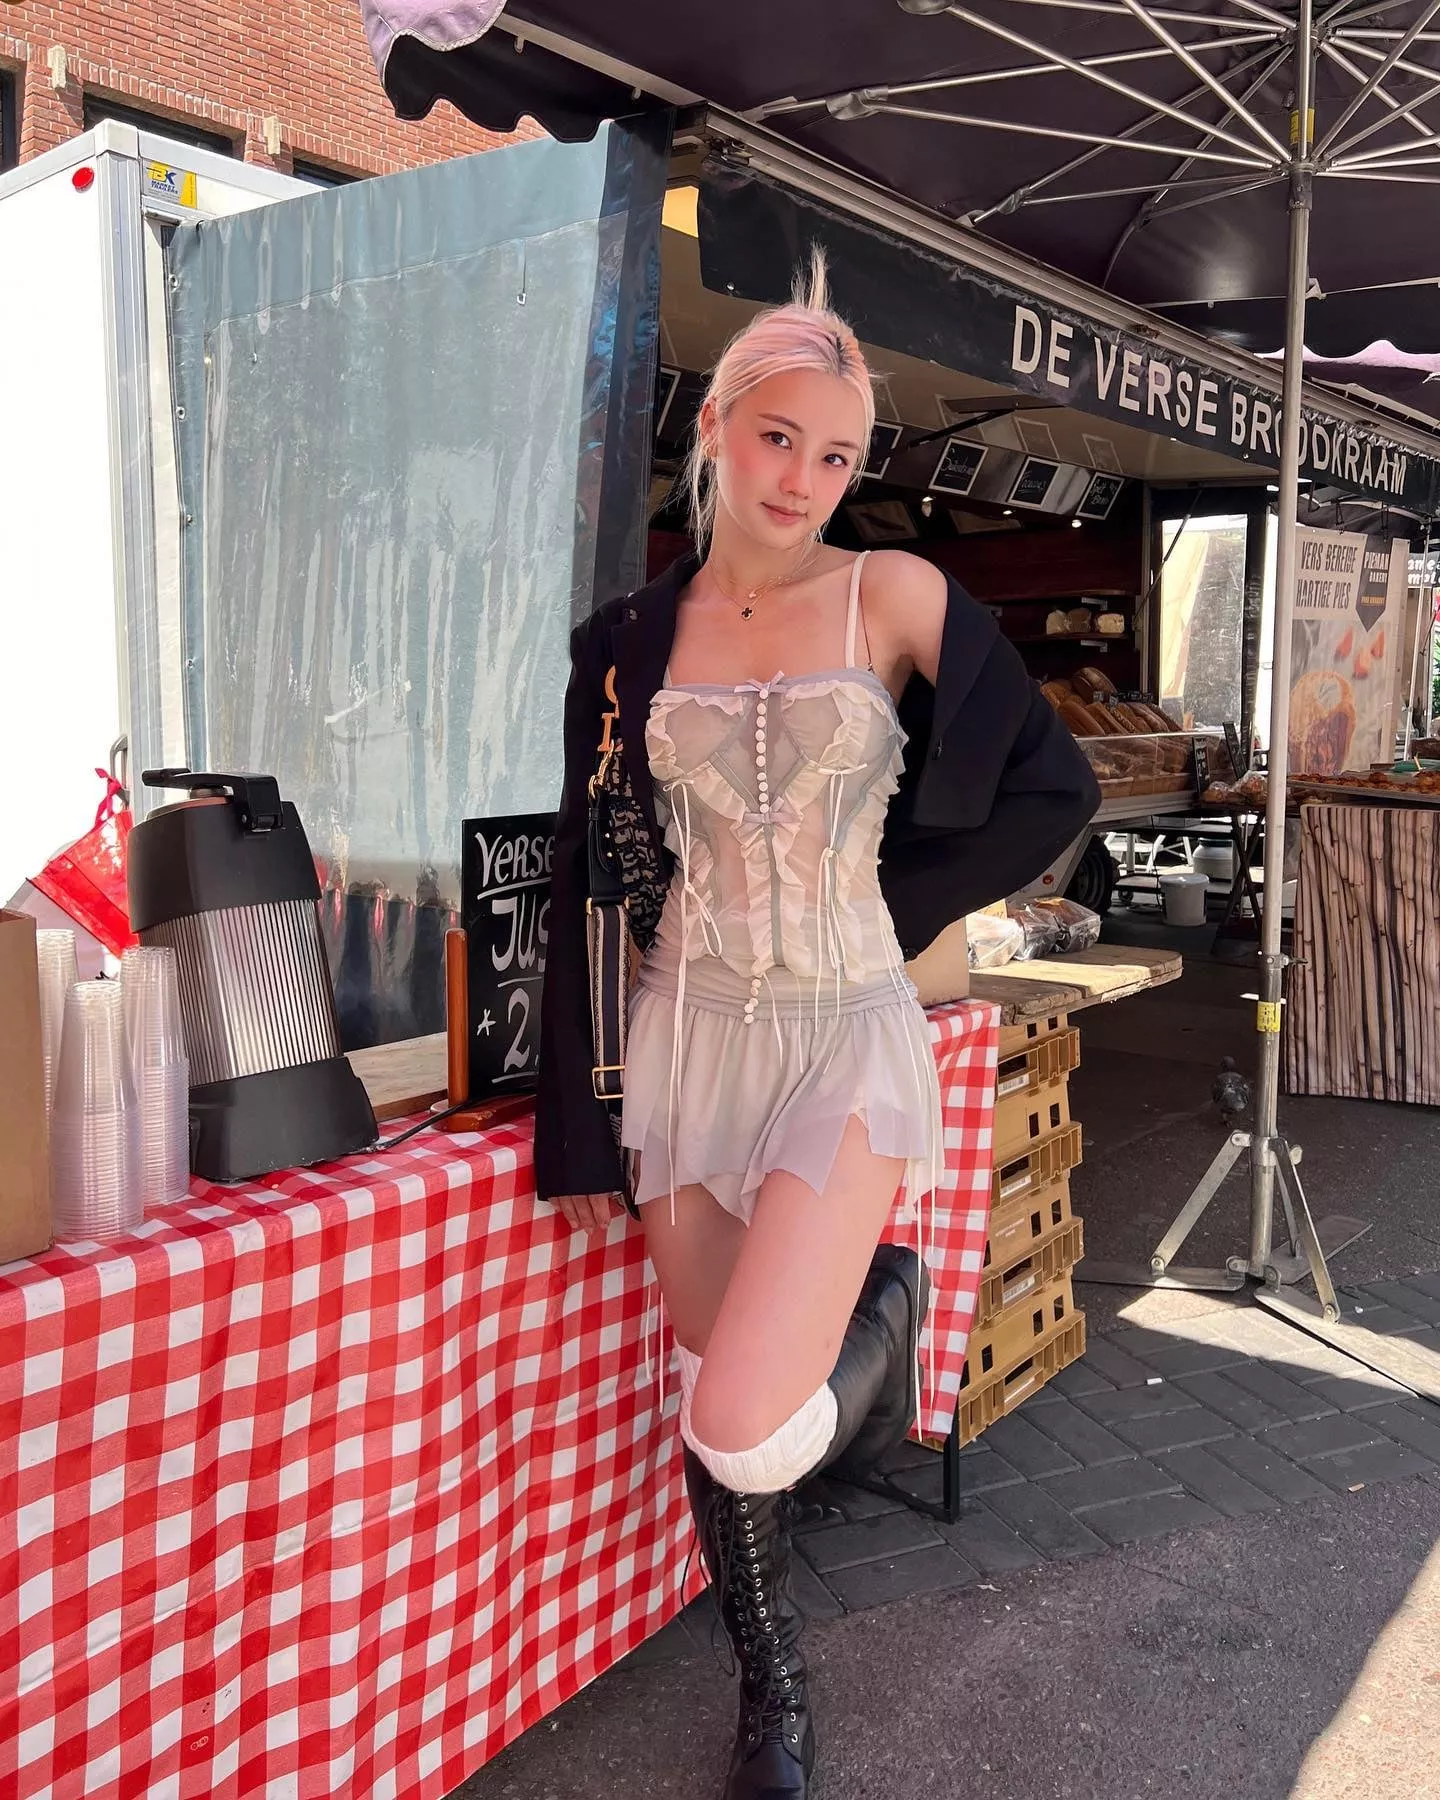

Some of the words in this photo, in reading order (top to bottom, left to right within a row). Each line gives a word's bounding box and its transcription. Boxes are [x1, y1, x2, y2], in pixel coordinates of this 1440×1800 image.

[1011, 304, 1074, 389] DE
[1094, 336, 1219, 437] VERSE
[1301, 541, 1324, 571] VERS
[1325, 544, 1358, 573] BEREIDE
[1296, 578, 1333, 608] HARTIGE
[1333, 581, 1351, 609] PIES
